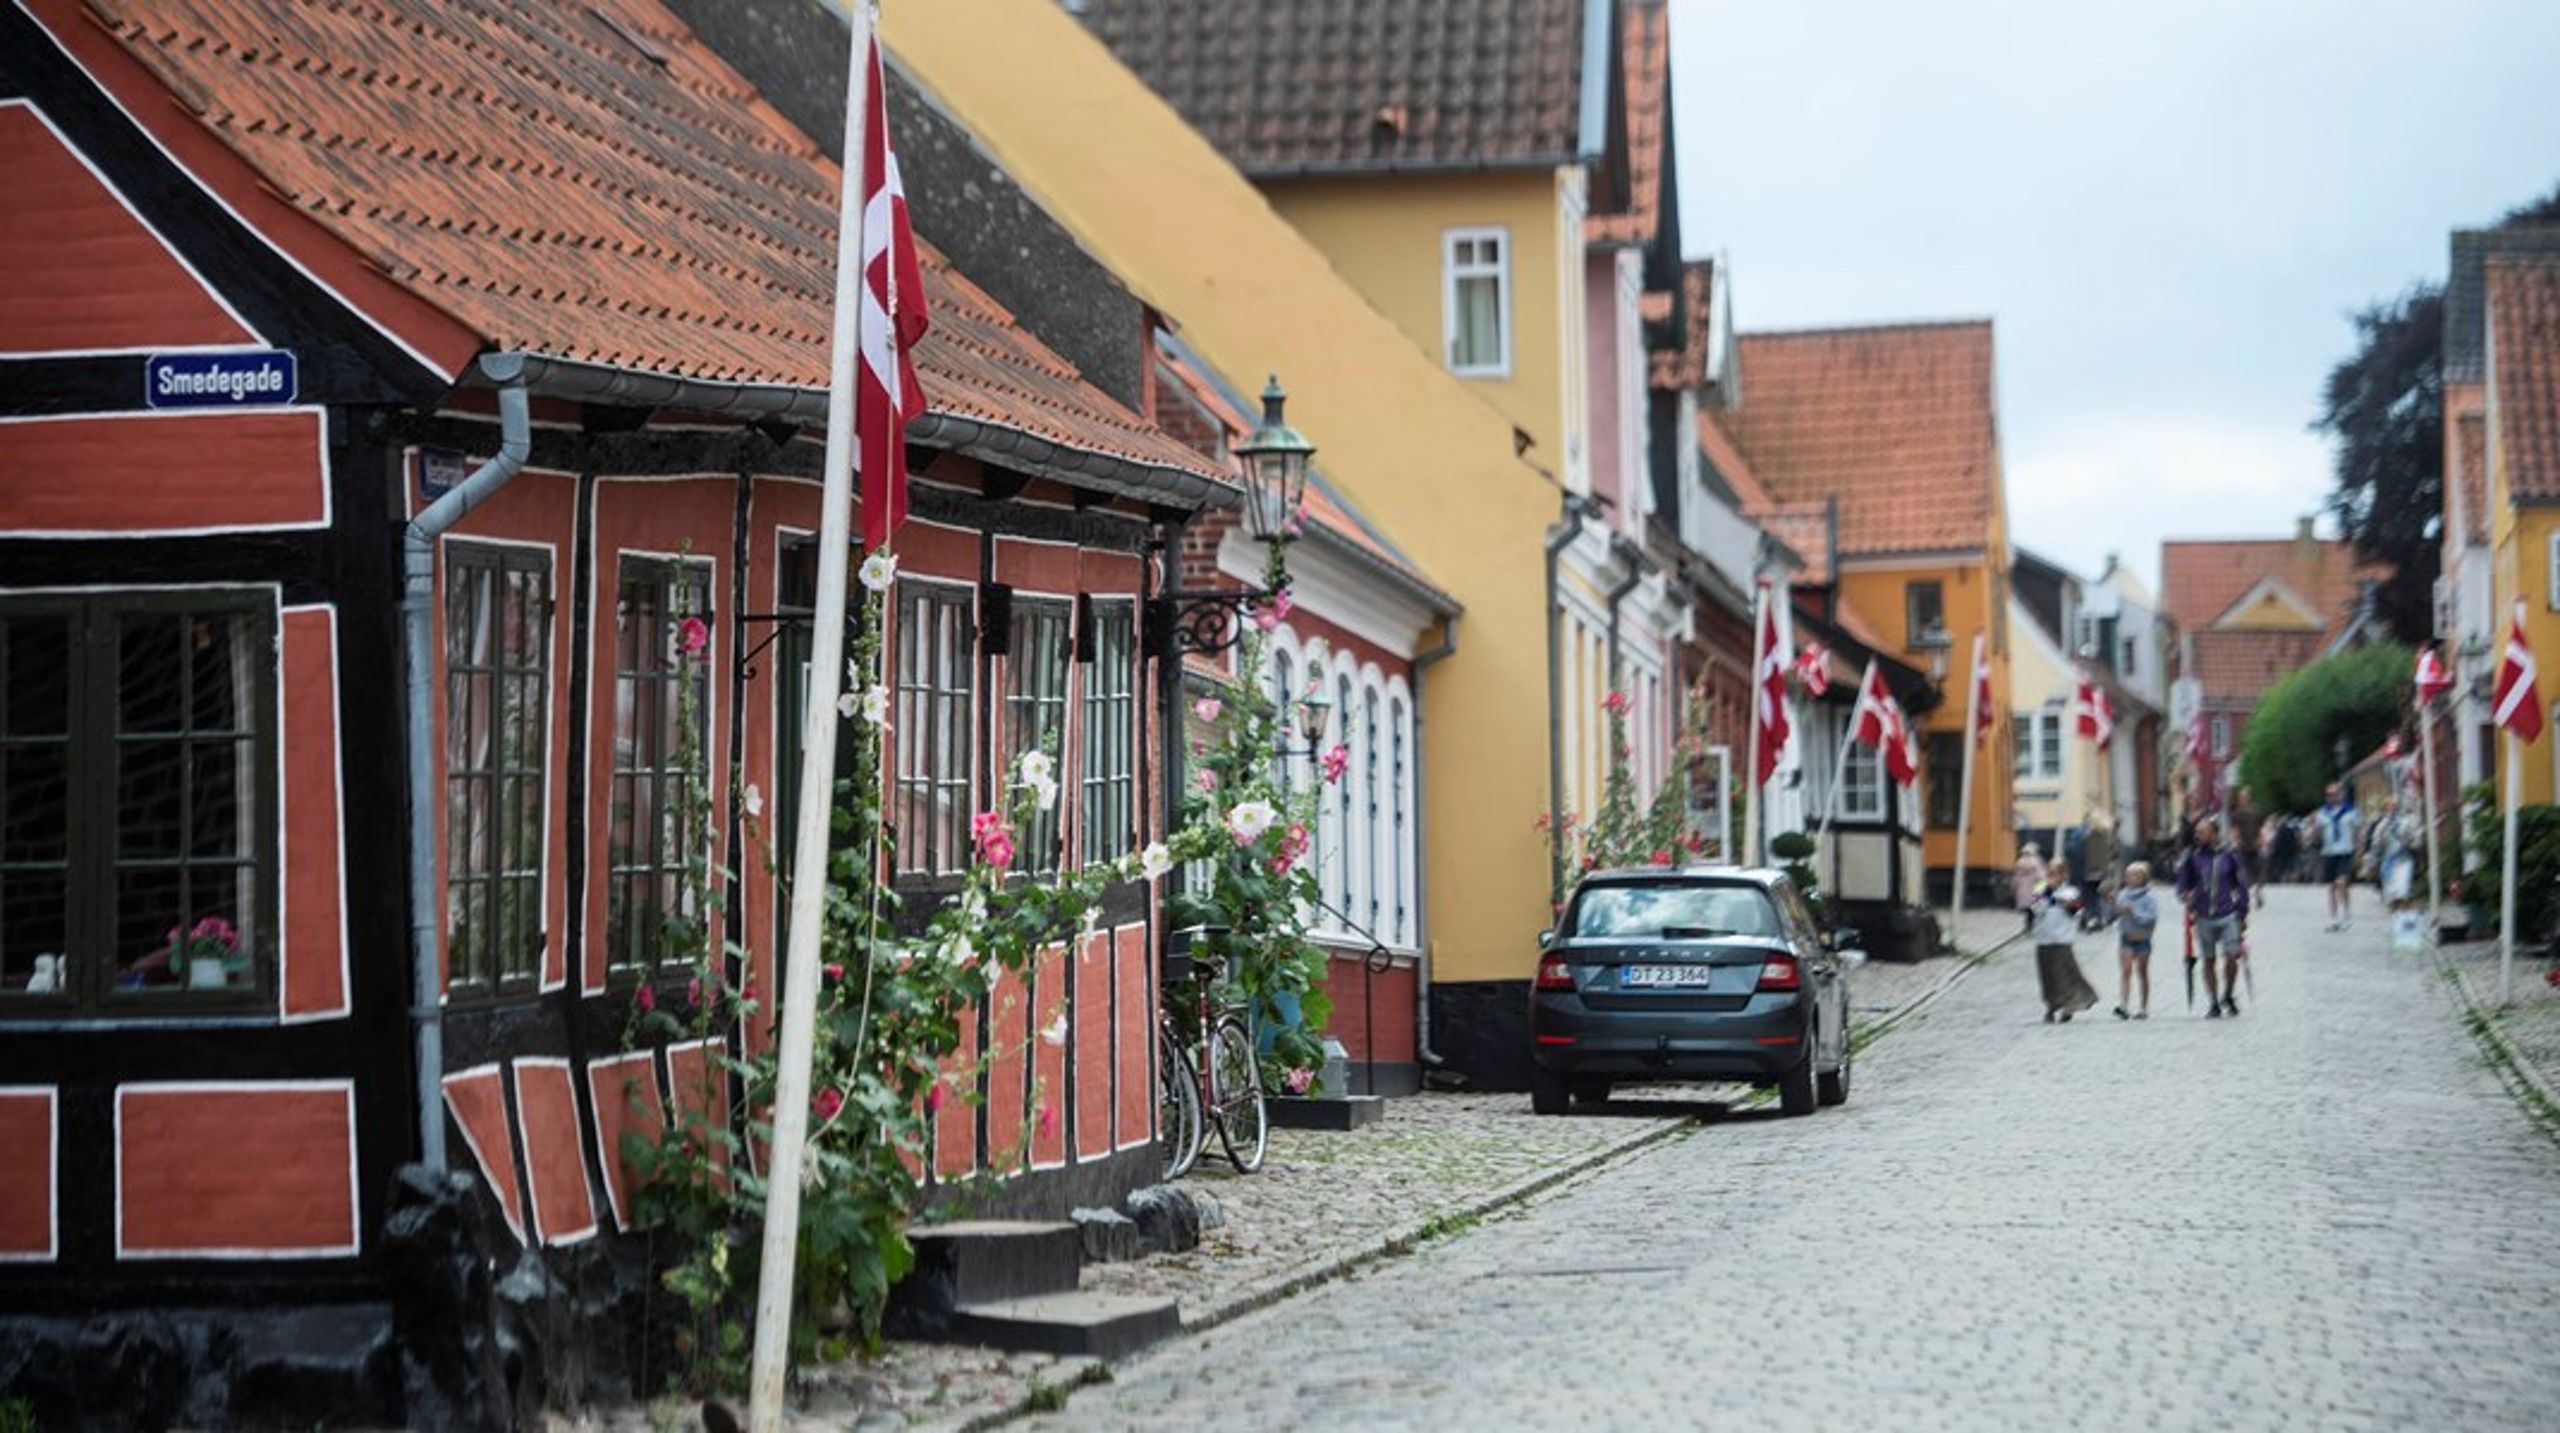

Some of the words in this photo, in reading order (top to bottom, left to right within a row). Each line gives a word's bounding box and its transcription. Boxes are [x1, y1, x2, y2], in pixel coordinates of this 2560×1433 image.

[158, 361, 284, 401] Smedegade
[1632, 967, 1651, 981] DT
[1657, 967, 1674, 981] 23
